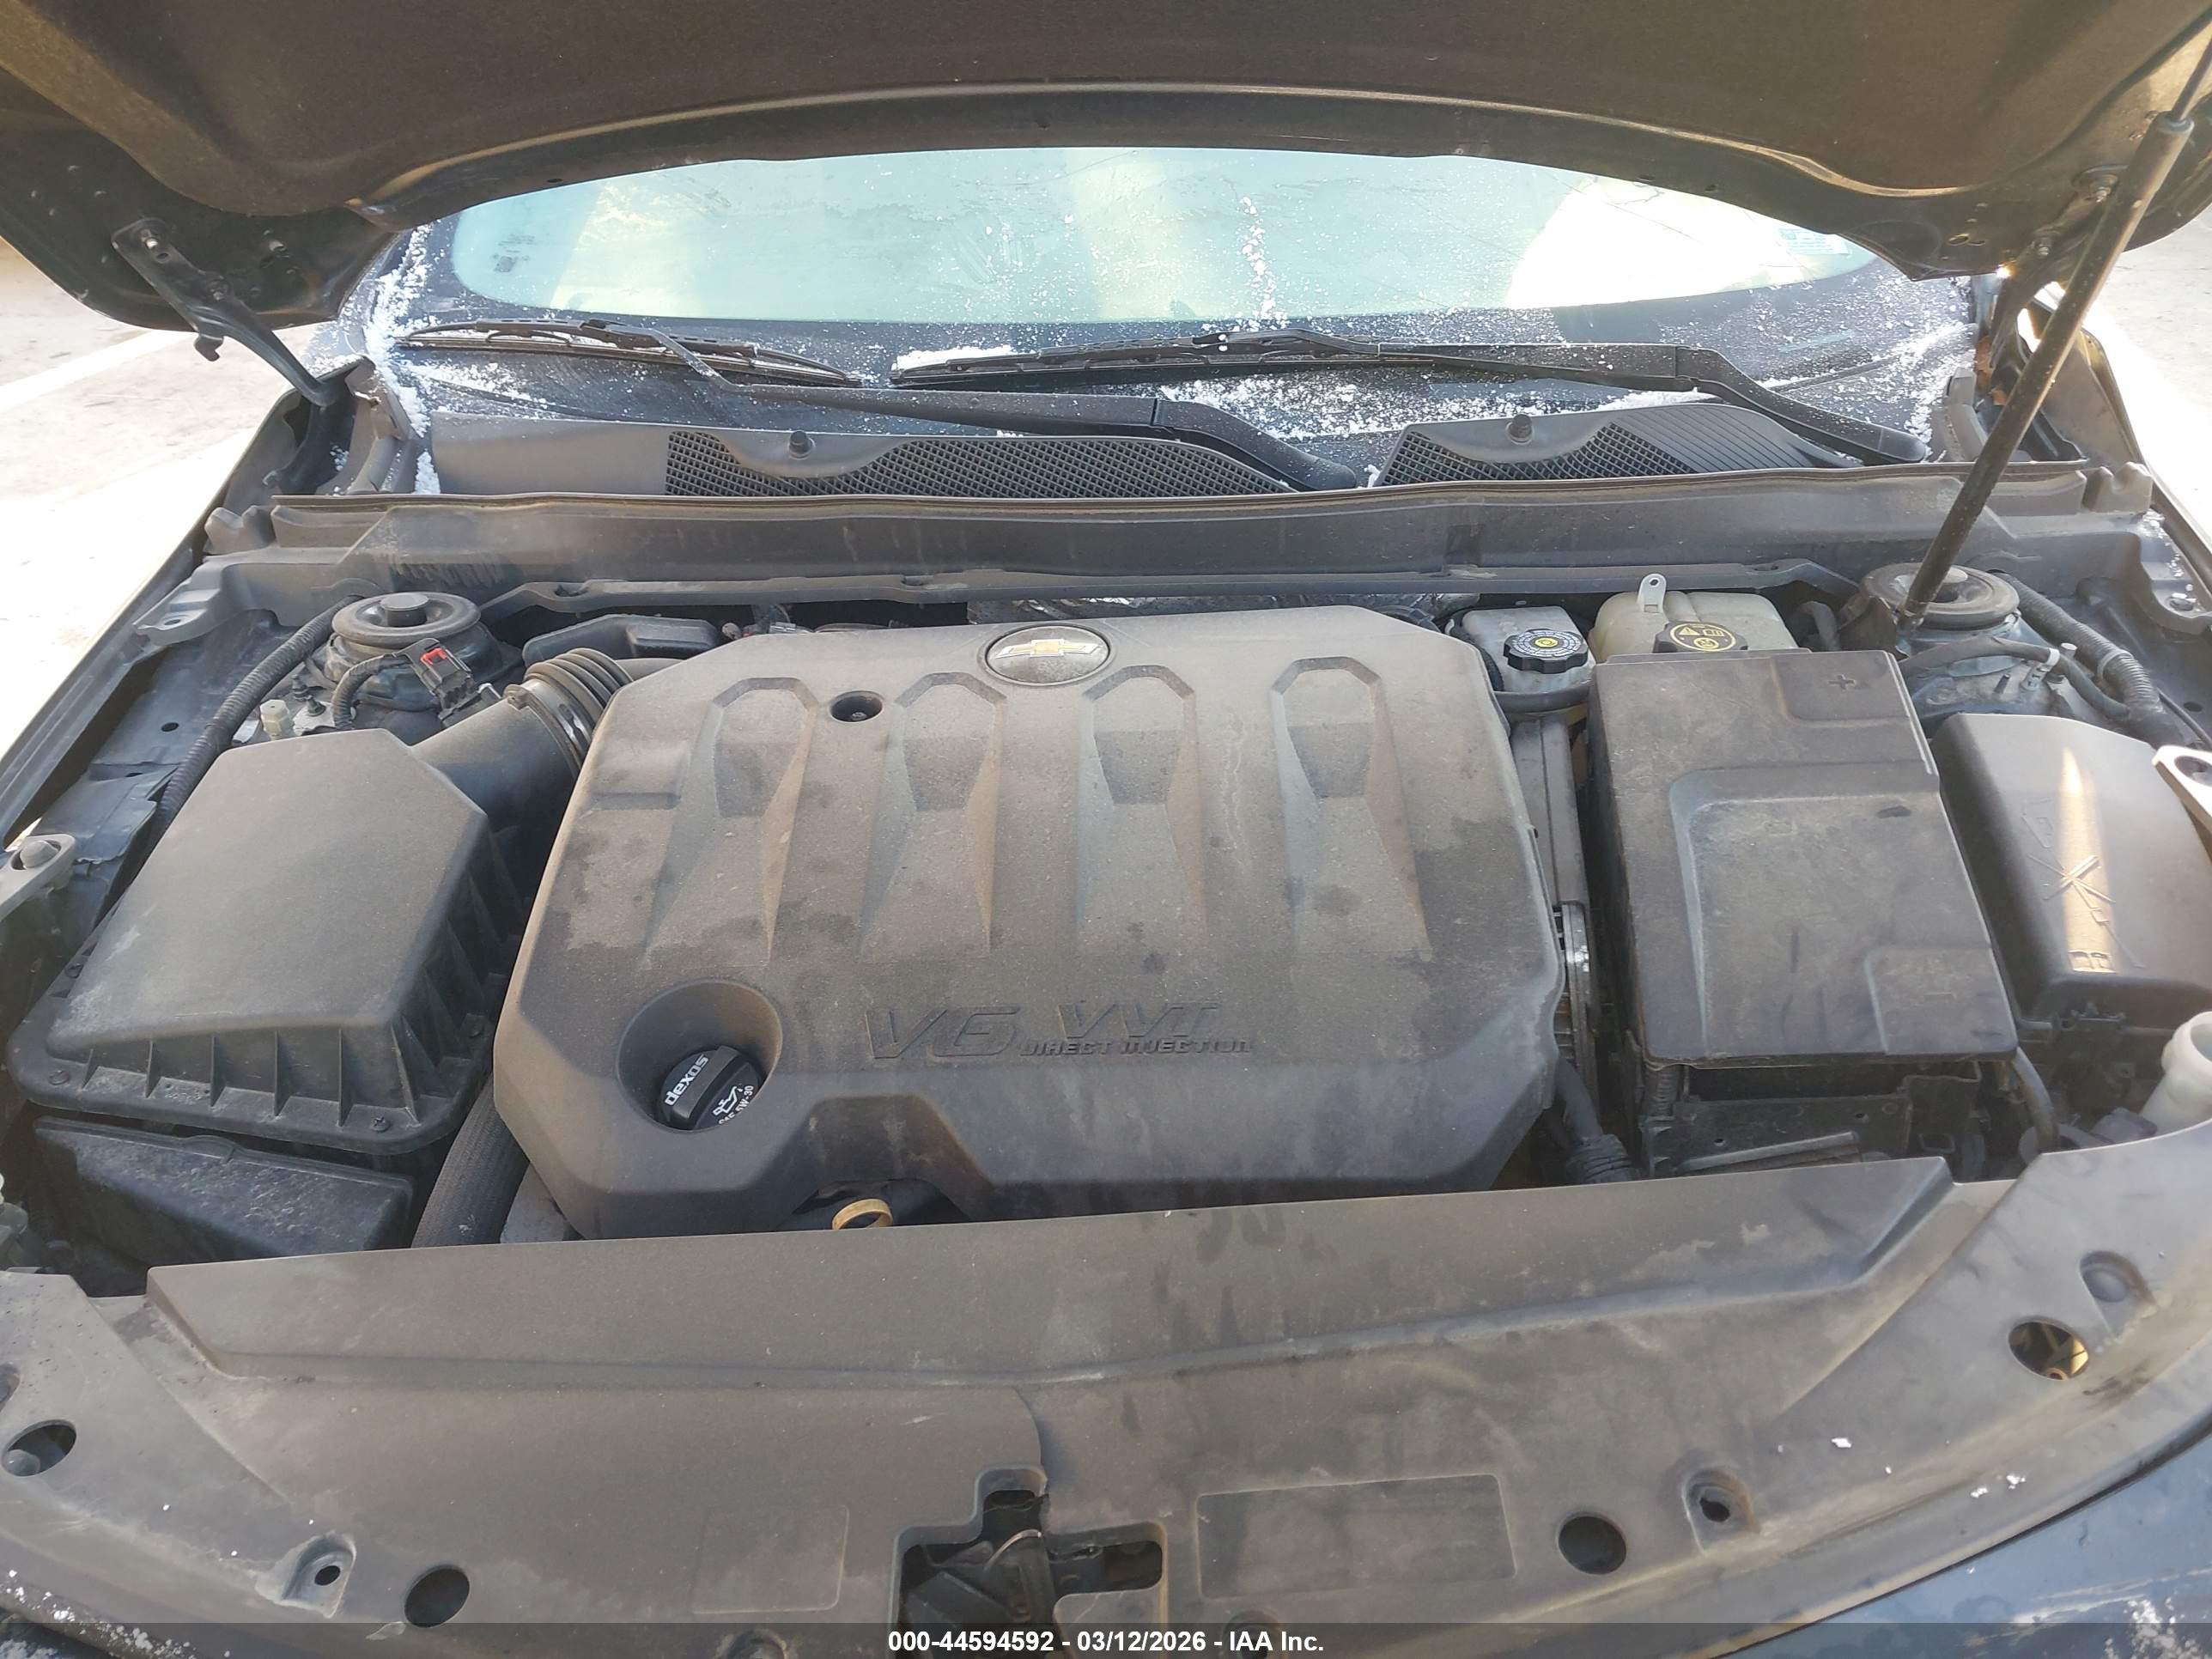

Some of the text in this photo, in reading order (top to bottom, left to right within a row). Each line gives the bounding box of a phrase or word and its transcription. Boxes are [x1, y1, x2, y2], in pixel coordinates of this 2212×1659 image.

[865, 1003, 1219, 1060] V6 VVT
[1020, 1039, 1114, 1056] DIRECT
[664, 1054, 708, 1106] dexos
